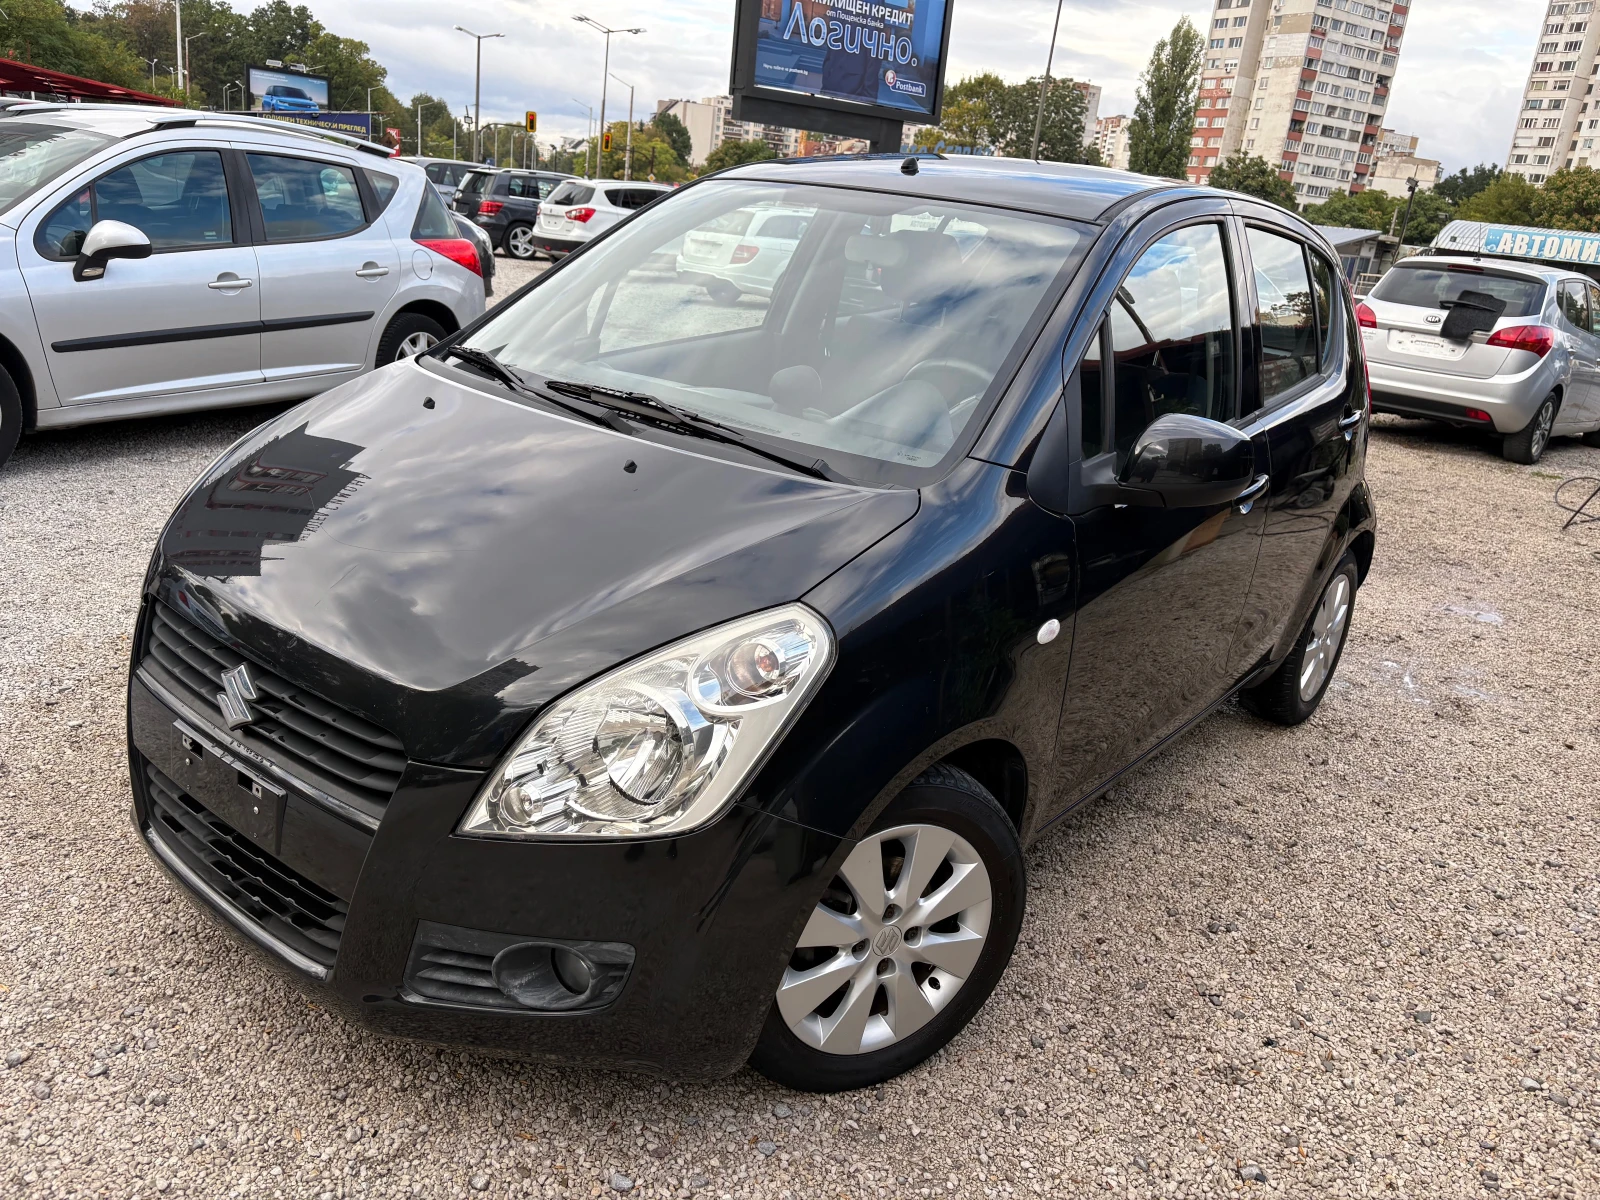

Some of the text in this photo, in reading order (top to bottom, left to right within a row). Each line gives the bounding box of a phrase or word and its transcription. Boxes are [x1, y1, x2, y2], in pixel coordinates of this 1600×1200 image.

[826, 9, 884, 29] от Пощенска банка
[871, 5, 914, 26] КРЕДИТ
[895, 80, 923, 94] Postbank
[338, 123, 367, 134] ПРЕГЛЕД
[1496, 232, 1600, 262] АВТОМИ
[1426, 315, 1441, 323] KIA
